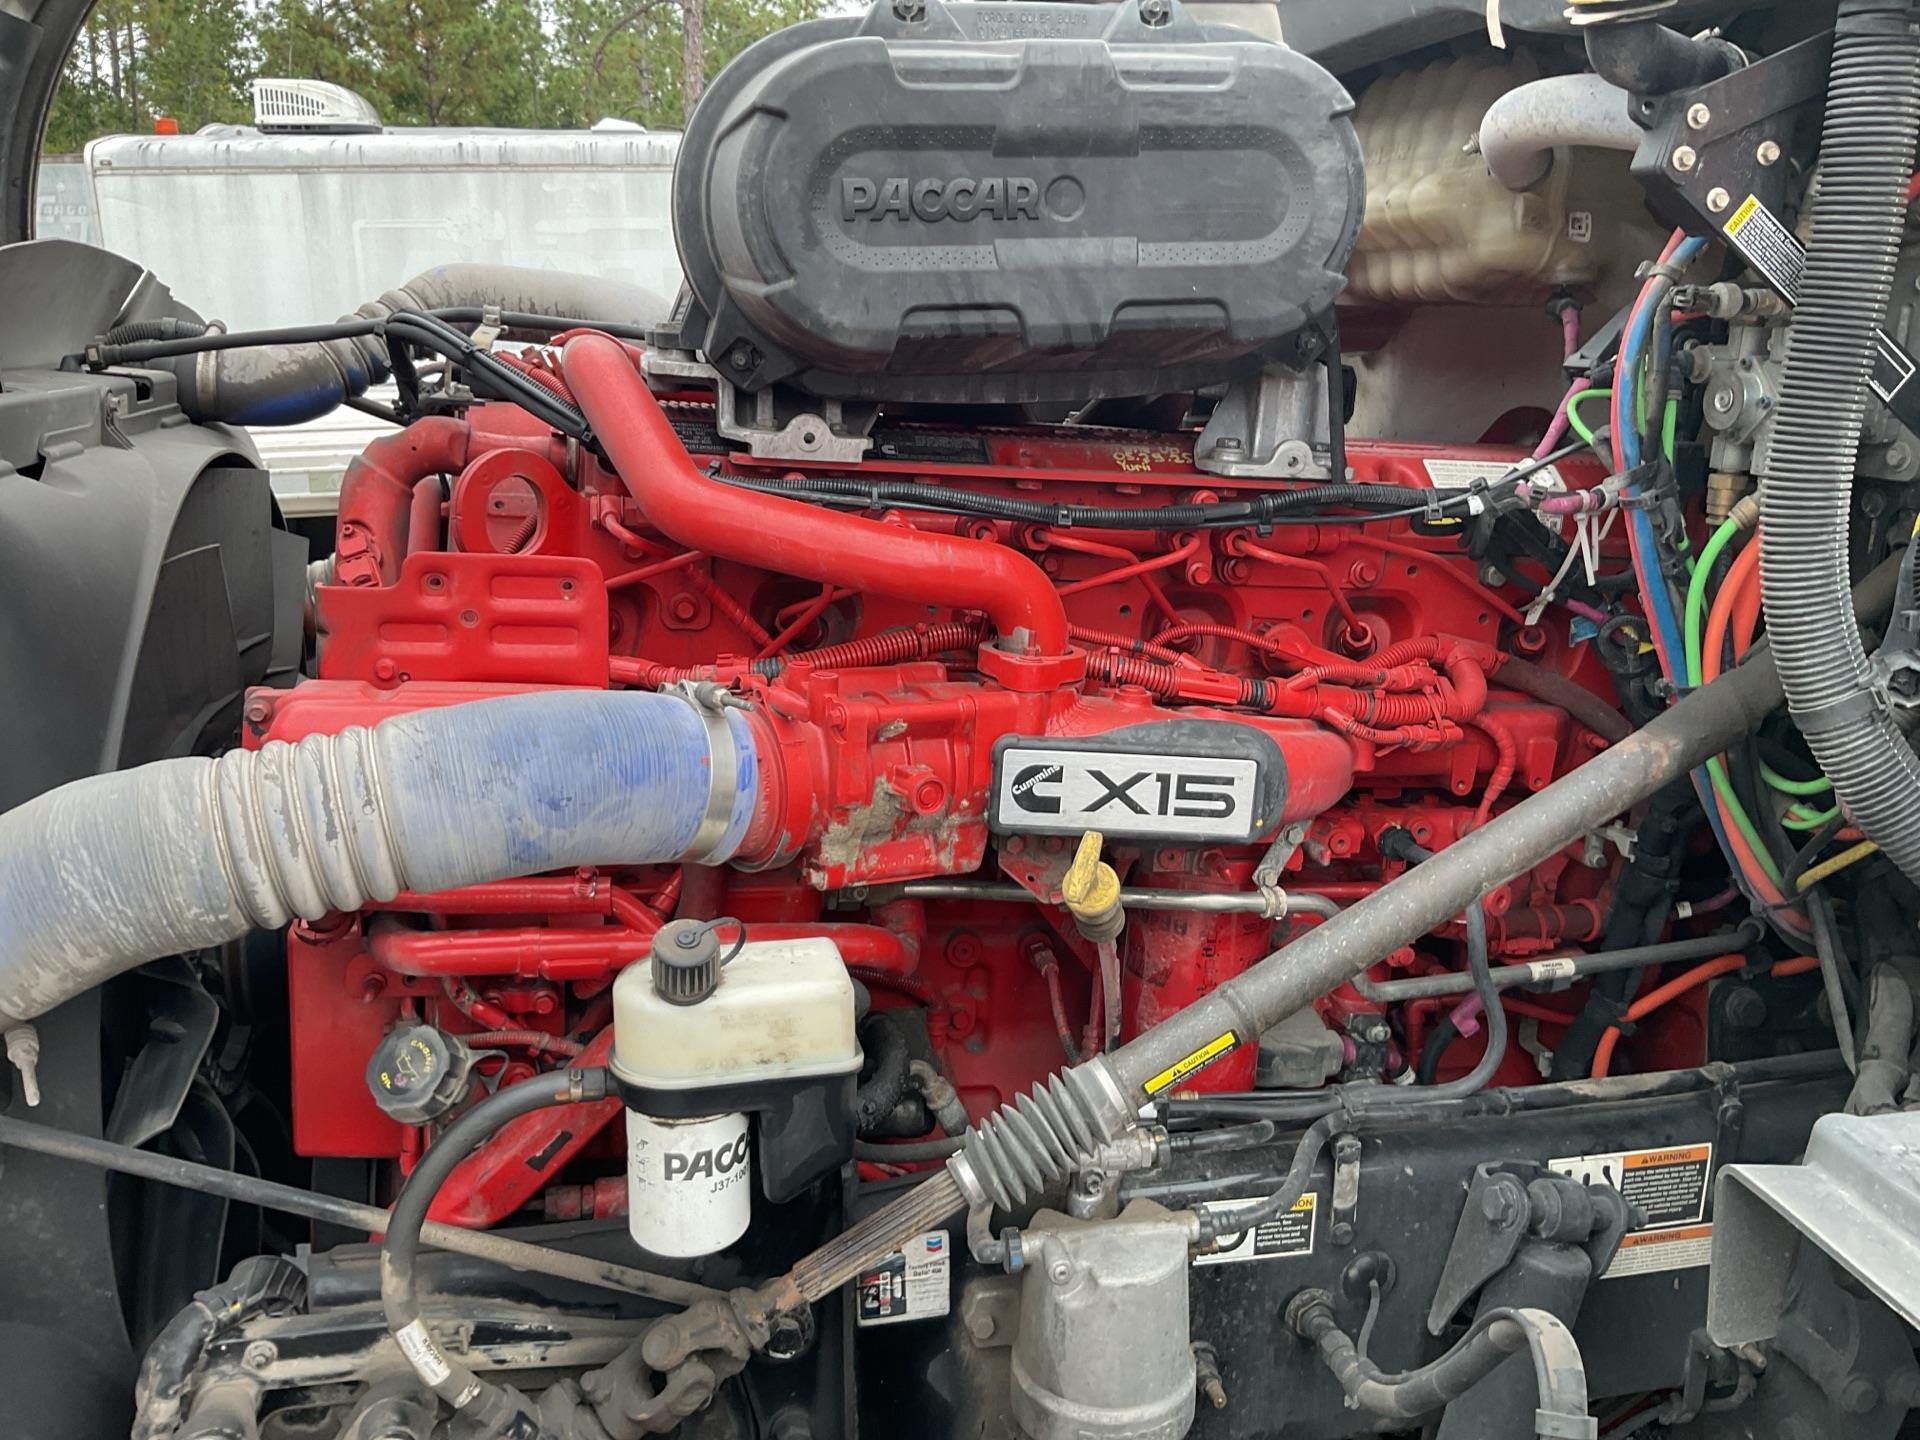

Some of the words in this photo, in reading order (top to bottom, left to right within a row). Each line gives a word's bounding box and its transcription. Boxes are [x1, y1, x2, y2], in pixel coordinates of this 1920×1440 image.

[842, 177, 1039, 223] PACCAR
[1729, 200, 1756, 232] CAUTION
[1012, 764, 1061, 795] Cummins
[1079, 769, 1236, 818] X15
[410, 1039, 432, 1072] ENGINE
[1183, 1049, 1210, 1069] CAUTION
[380, 1071, 391, 1089] OIL
[664, 1132, 749, 1181] PACC
[1649, 1151, 1691, 1162] WARNING
[1640, 1232, 1681, 1242] WARNING
